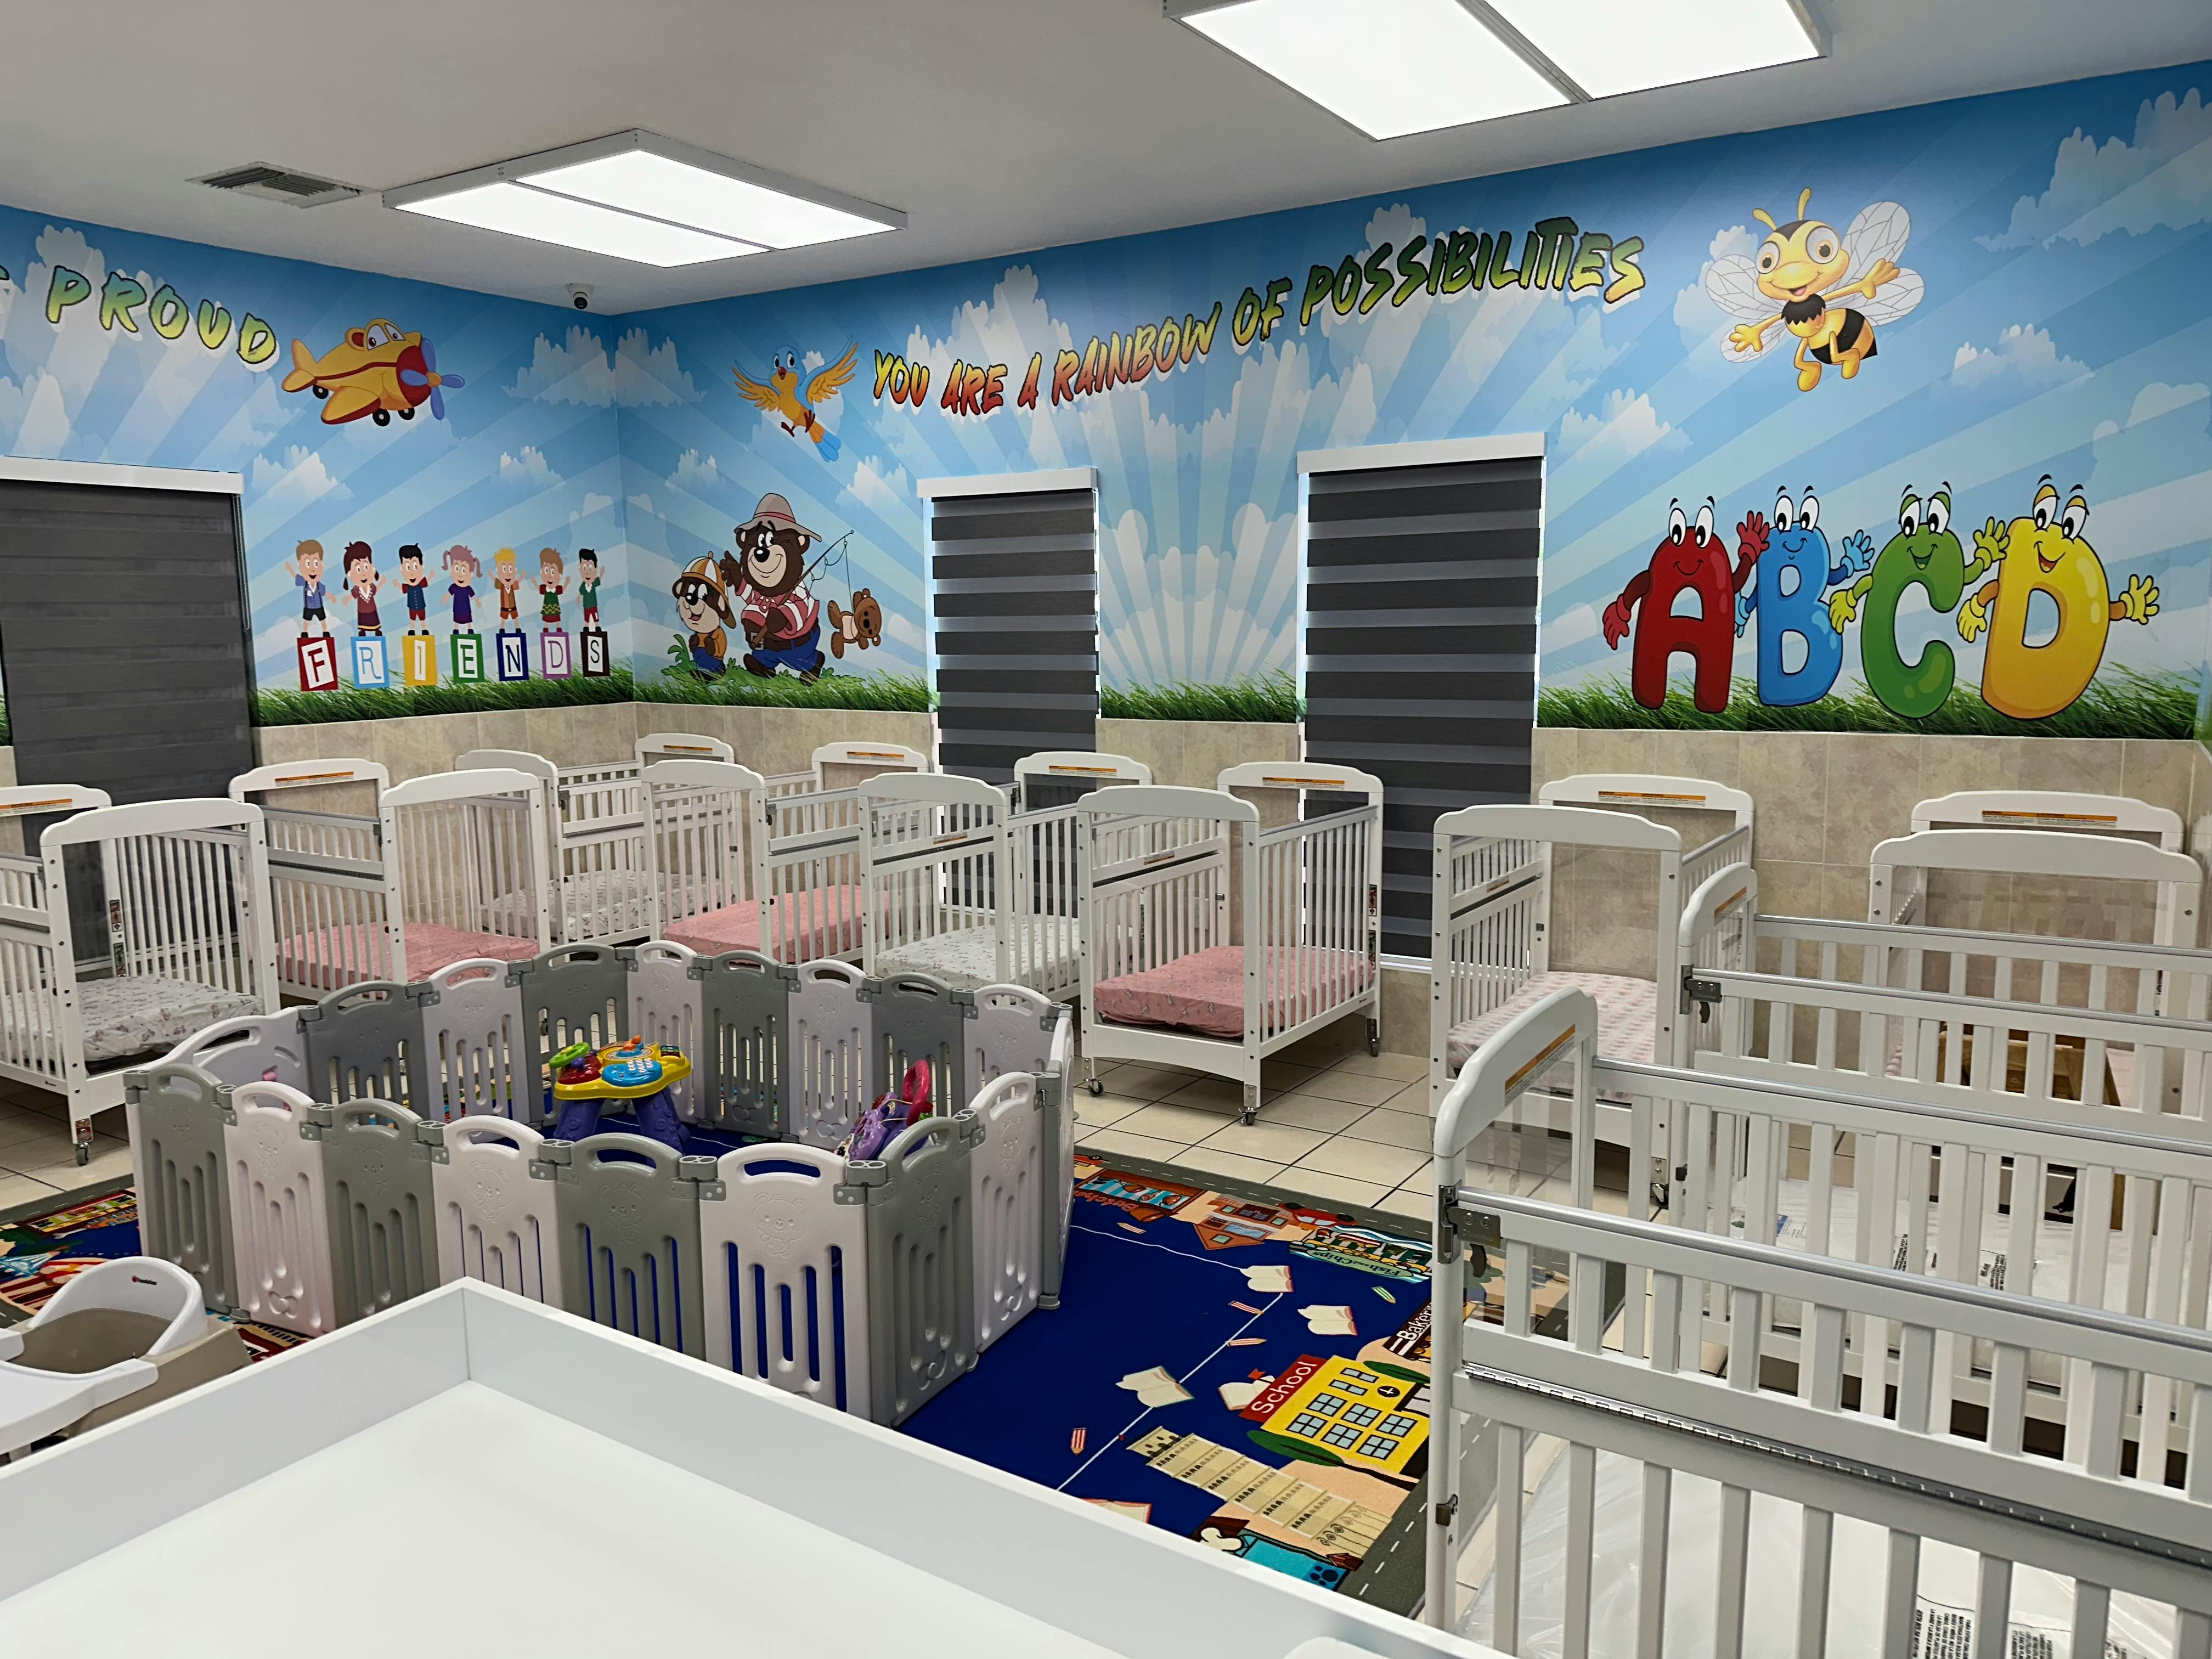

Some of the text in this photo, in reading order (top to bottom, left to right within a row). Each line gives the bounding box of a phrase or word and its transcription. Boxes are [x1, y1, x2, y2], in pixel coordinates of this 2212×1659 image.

[45, 264, 277, 364] PROUD
[873, 216, 1646, 416] YOU ARE A RAINBOW OF POSSIBILITIES
[1074, 1190, 1139, 1212] Butche
[1313, 1251, 1353, 1265] Chips
[1370, 1265, 1402, 1276] Fish
[1251, 1361, 1318, 1413] School
